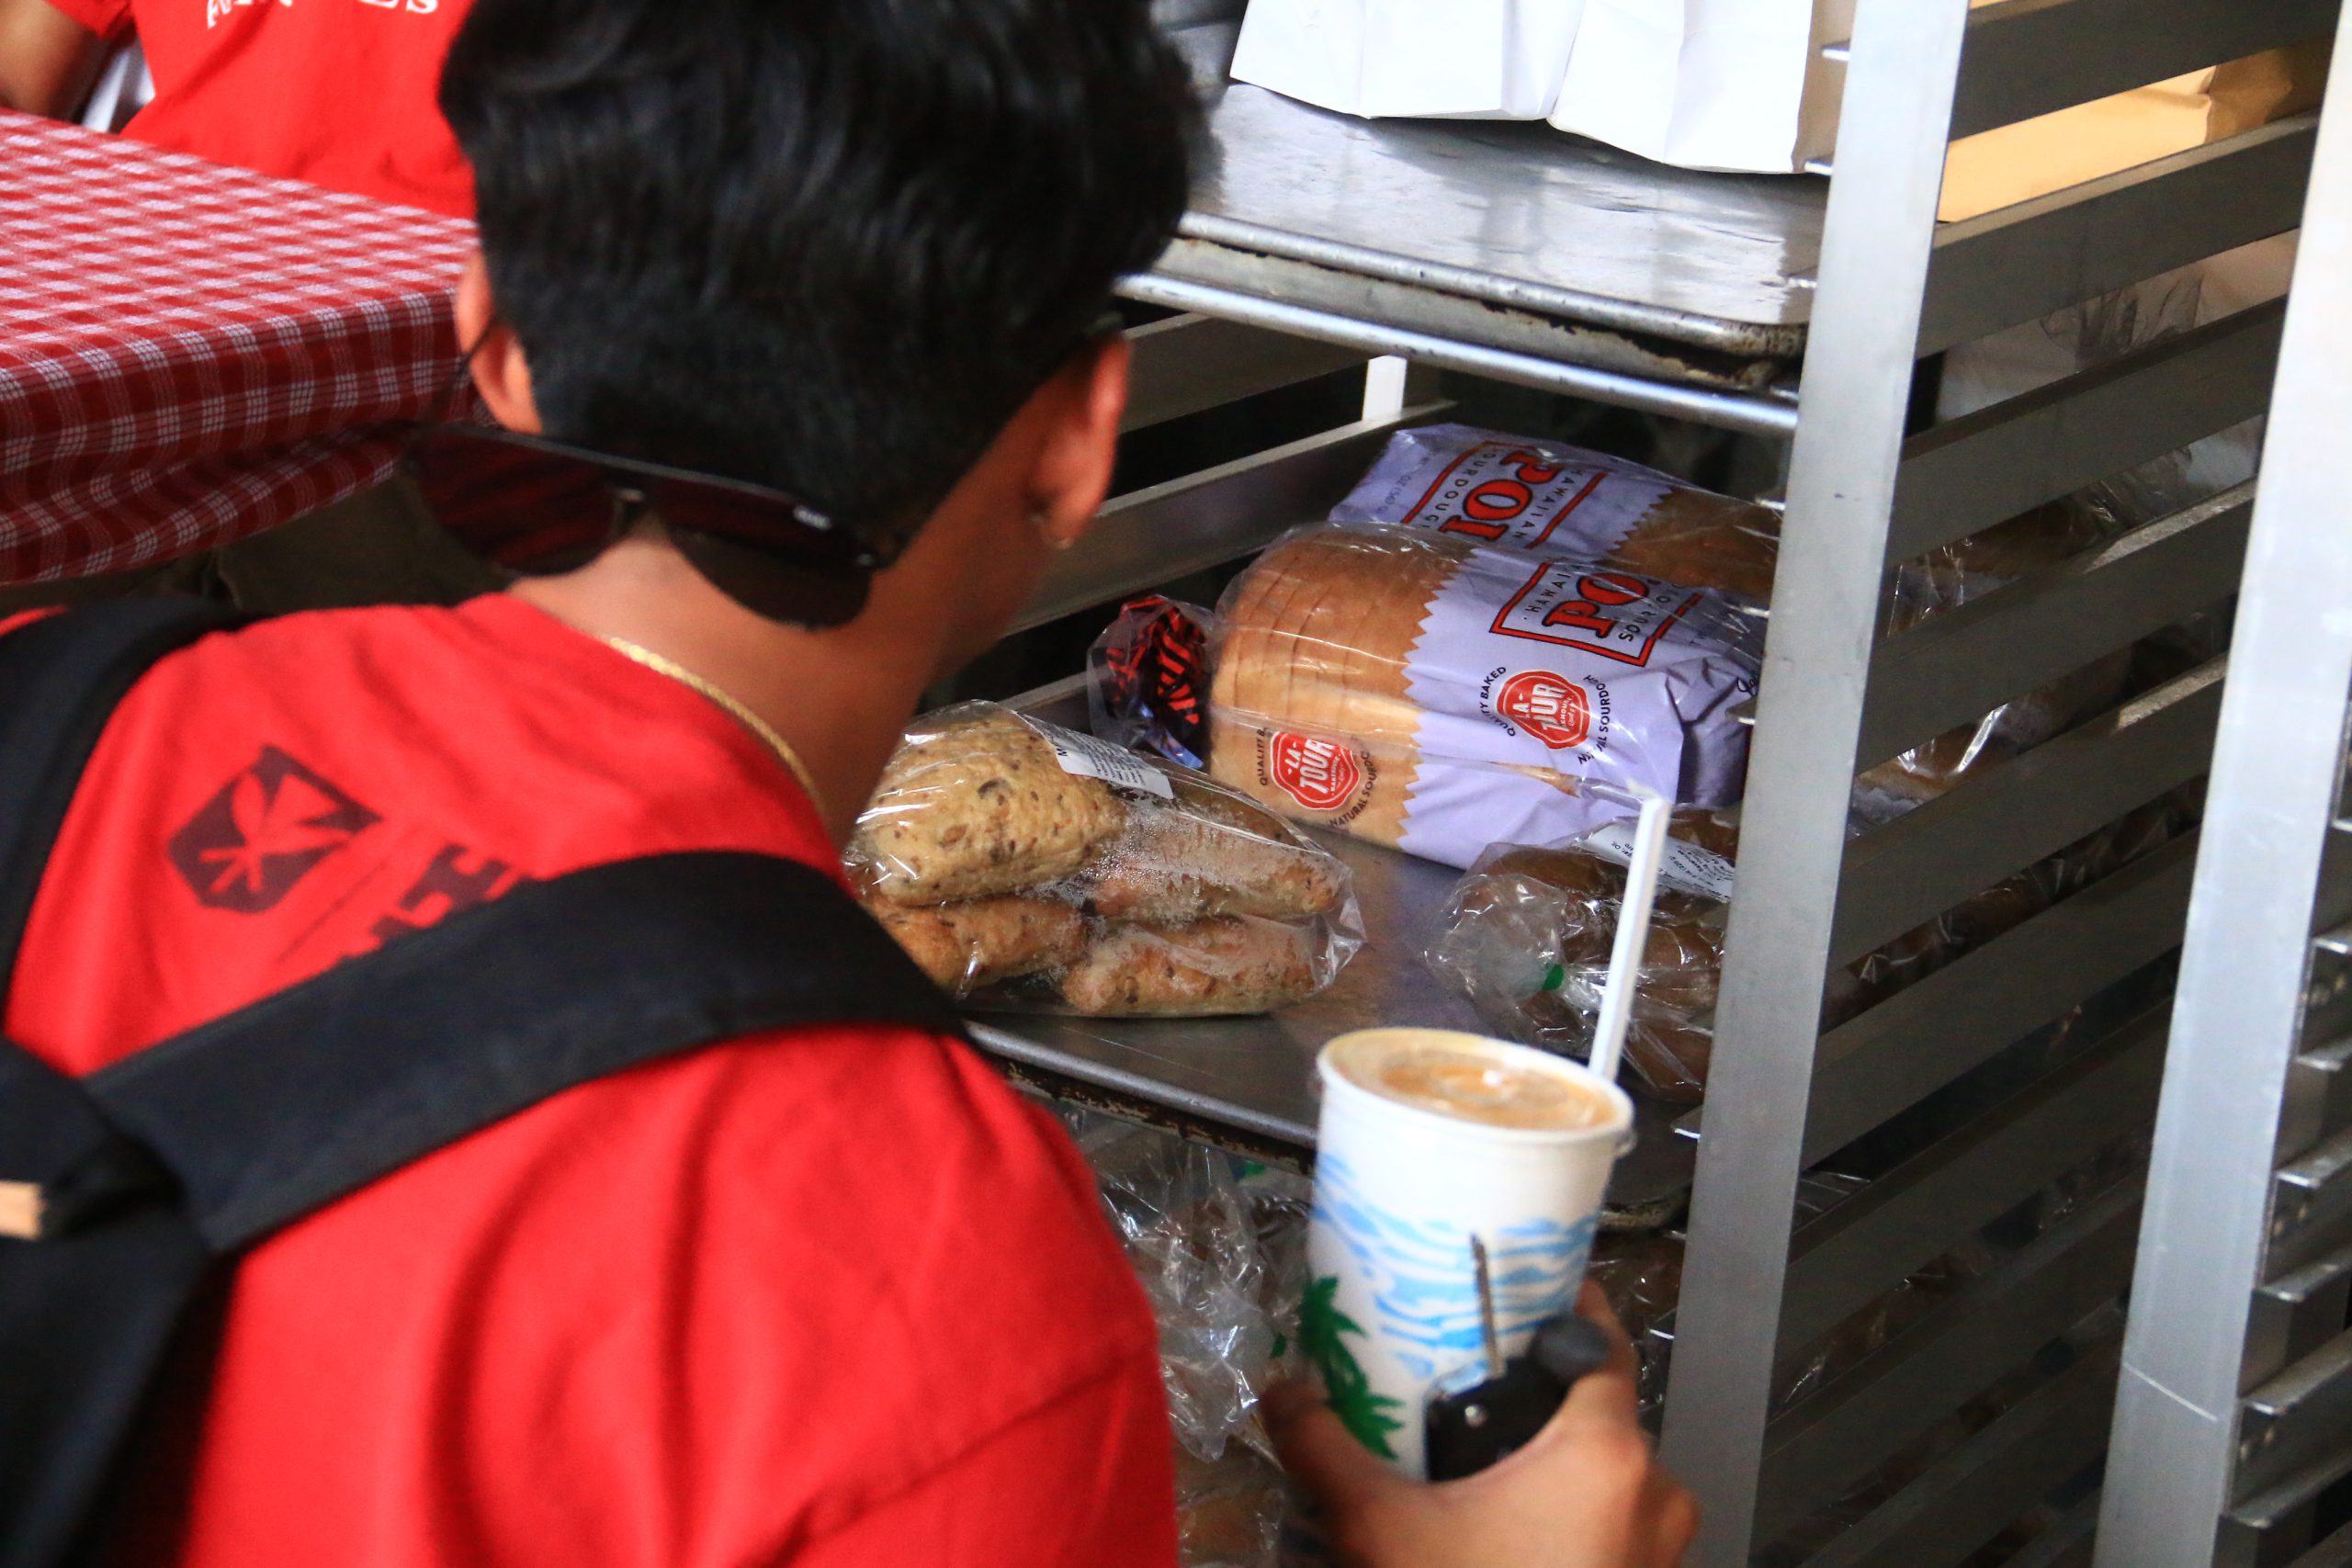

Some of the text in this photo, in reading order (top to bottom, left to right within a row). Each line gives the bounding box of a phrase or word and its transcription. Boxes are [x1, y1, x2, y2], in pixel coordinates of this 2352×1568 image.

[1438, 450, 1566, 542] POI
[1542, 572, 1661, 639] PO
[1479, 666, 1507, 700] BAKED
[1256, 736, 1268, 787] QUALITY
[1284, 748, 1302, 770] LA
[1299, 739, 1335, 795] TOUR
[1329, 798, 1368, 827] NATURAL
